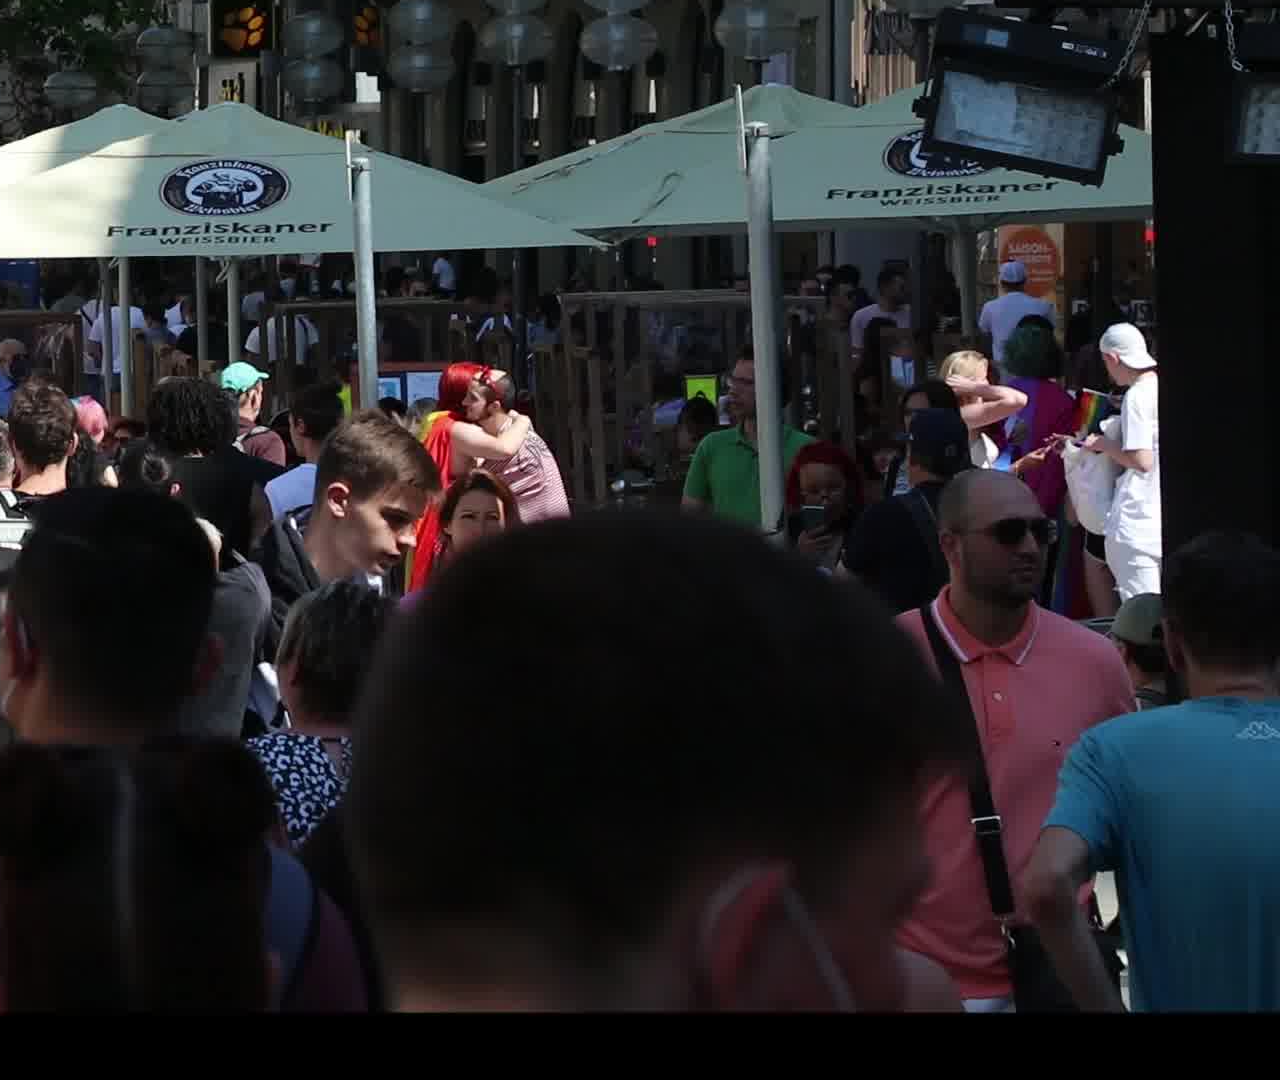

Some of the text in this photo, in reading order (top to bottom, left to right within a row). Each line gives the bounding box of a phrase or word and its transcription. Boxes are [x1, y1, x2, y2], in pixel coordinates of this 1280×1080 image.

[825, 181, 1059, 200] Franziskaner
[879, 194, 1001, 207] WEISSBIER
[107, 222, 335, 237] Franziskaner
[159, 235, 277, 245] WEISSBIER
